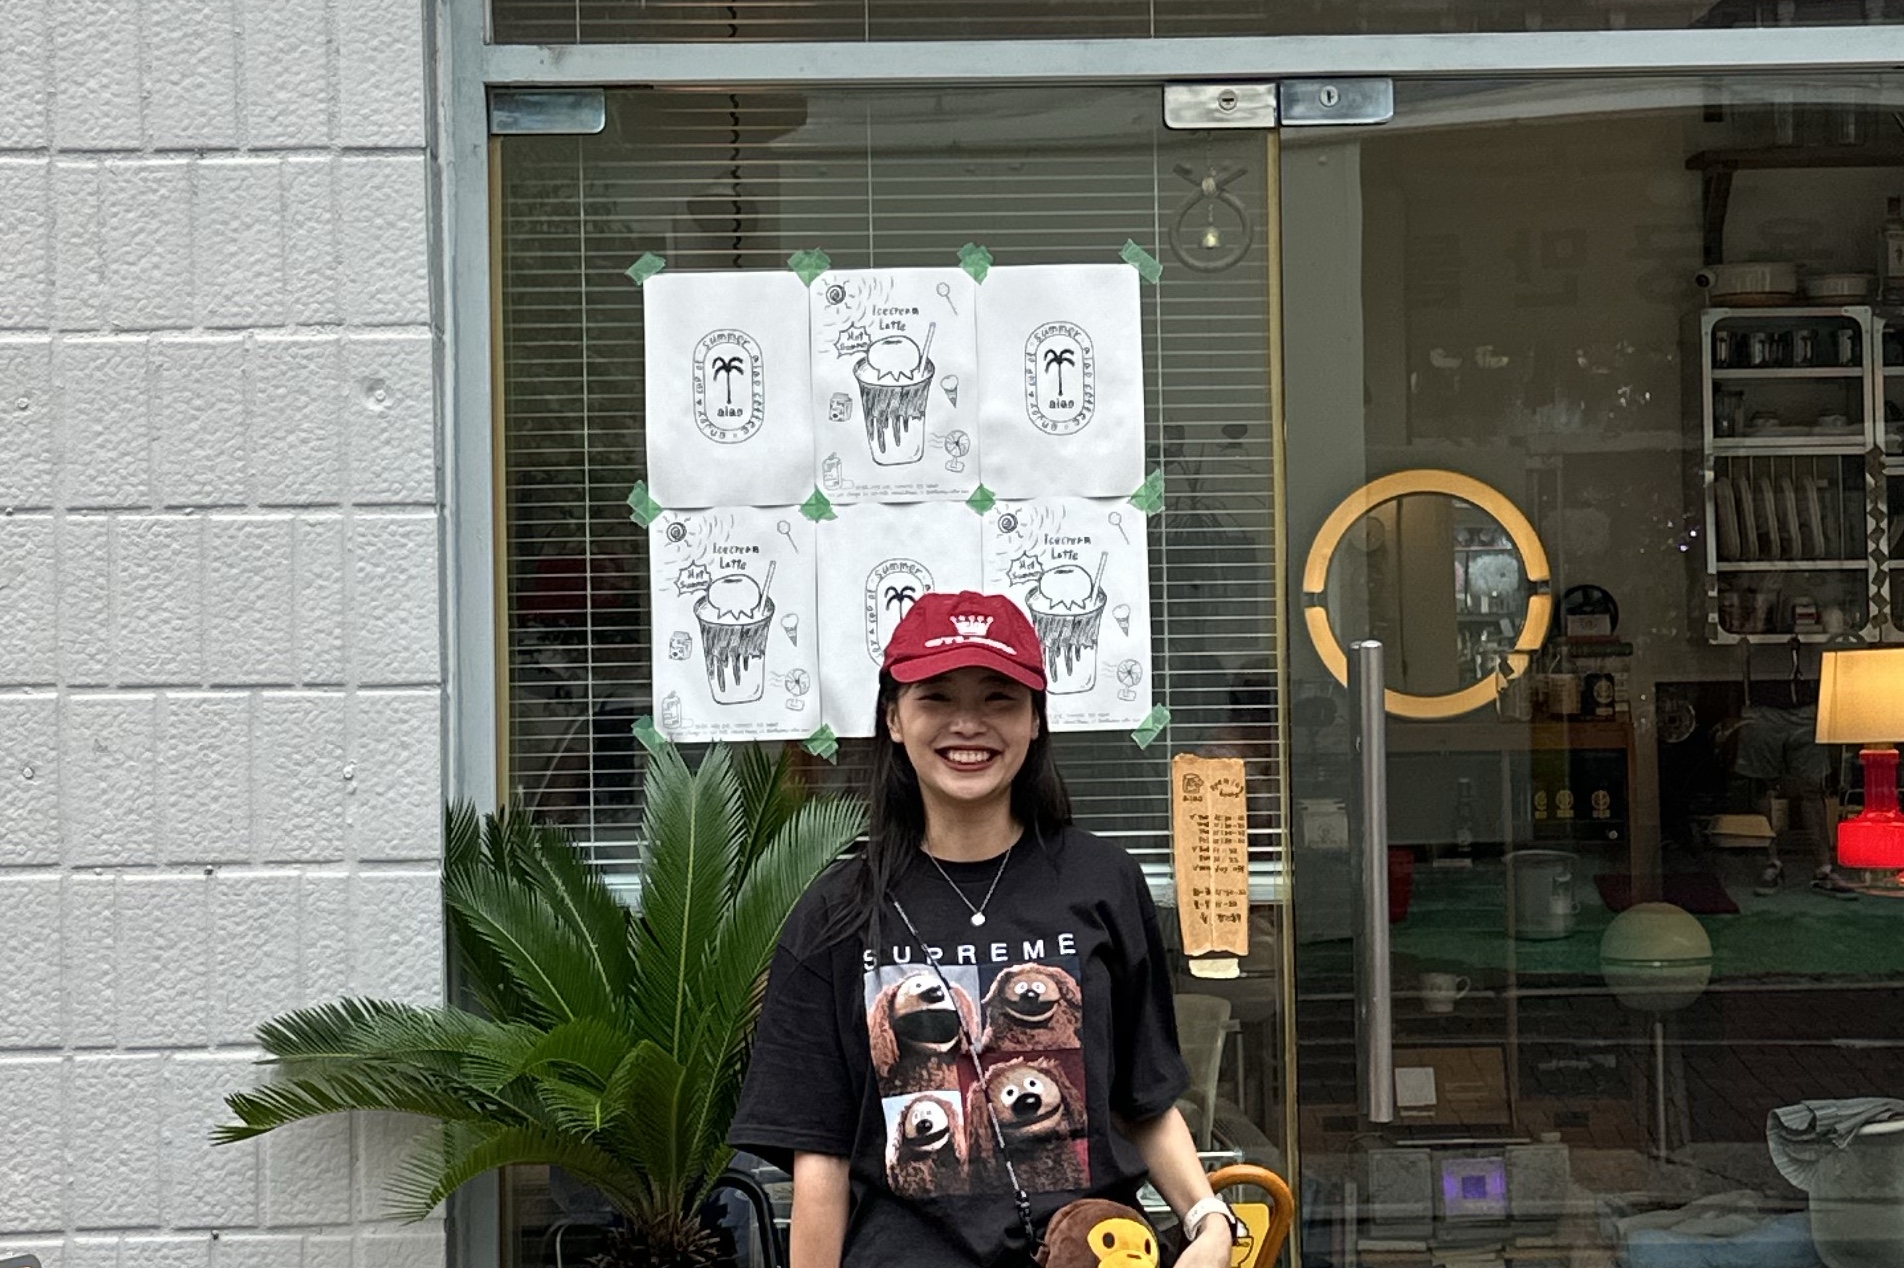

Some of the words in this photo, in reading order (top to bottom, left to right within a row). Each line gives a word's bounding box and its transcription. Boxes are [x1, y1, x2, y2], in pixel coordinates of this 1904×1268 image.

[879, 317, 906, 331] Latte
[1051, 547, 1079, 560] Latte
[719, 556, 747, 570] Latte
[863, 933, 1077, 971] SUPREME
